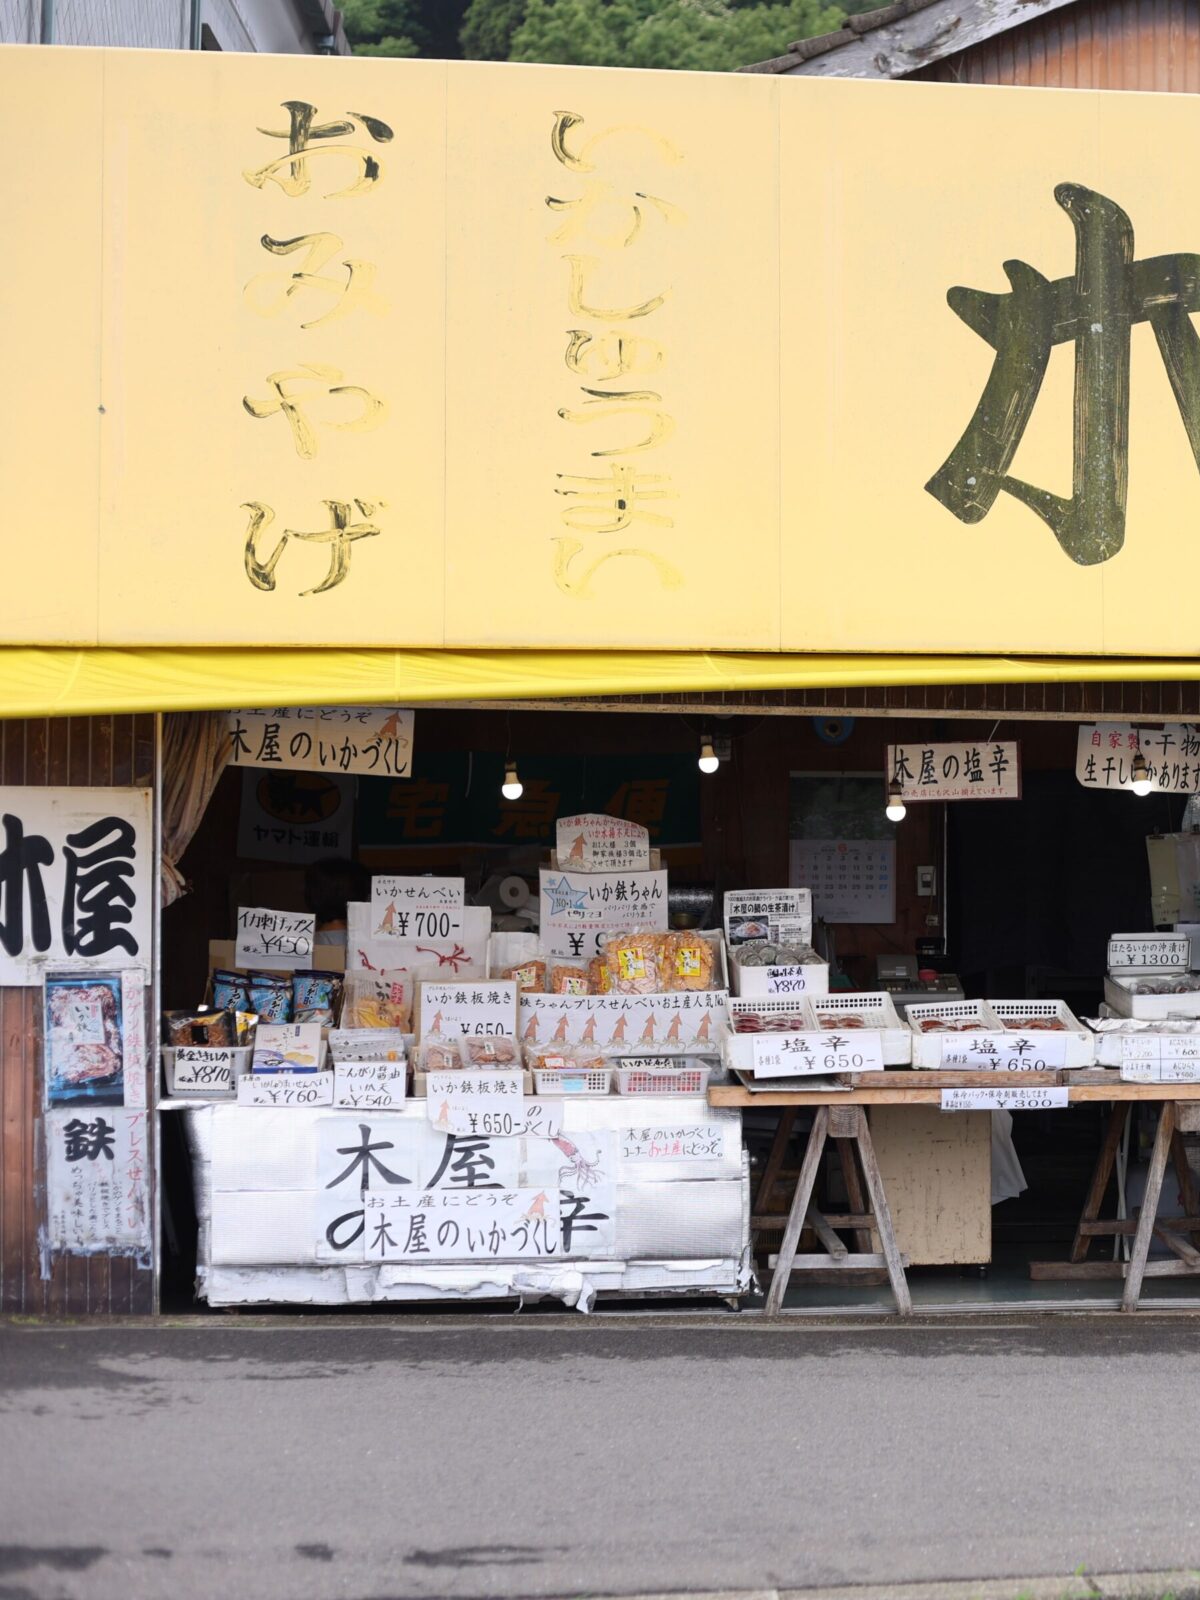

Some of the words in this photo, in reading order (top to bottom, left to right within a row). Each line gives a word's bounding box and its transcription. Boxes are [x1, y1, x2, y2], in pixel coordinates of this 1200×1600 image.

[240, 101, 395, 598] おみやげ
[229, 719, 409, 775] 木屋のいかづくし
[893, 744, 1011, 786] 木屋の塩辛
[252, 824, 340, 849] ヤマト運輸
[376, 886, 461, 899] いかせんべい
[588, 879, 663, 902] いか鉄ちゃん
[397, 911, 460, 938] ¥700-
[260, 933, 312, 957] ¥450
[1111, 941, 1186, 953] ほたるいかの沖漬け
[1126, 954, 1188, 965] ¥1300-
[427, 991, 512, 1005] いか鉄板焼き
[780, 1034, 850, 1054] 塩辛
[968, 1037, 1037, 1056] 塩辛
[803, 1054, 877, 1070] ¥650-
[191, 1065, 231, 1083] ¥870
[431, 1079, 519, 1096] いか鉄板焼き
[468, 1112, 521, 1135] ¥650-
[625, 1126, 717, 1142] 木屋のいかづくし
[62, 1117, 116, 1163] 鉄
[324, 1123, 508, 1191] 木屋
[366, 1192, 520, 1209] お土産にどうぞ
[369, 1211, 560, 1255] 木屋のいかづくし
